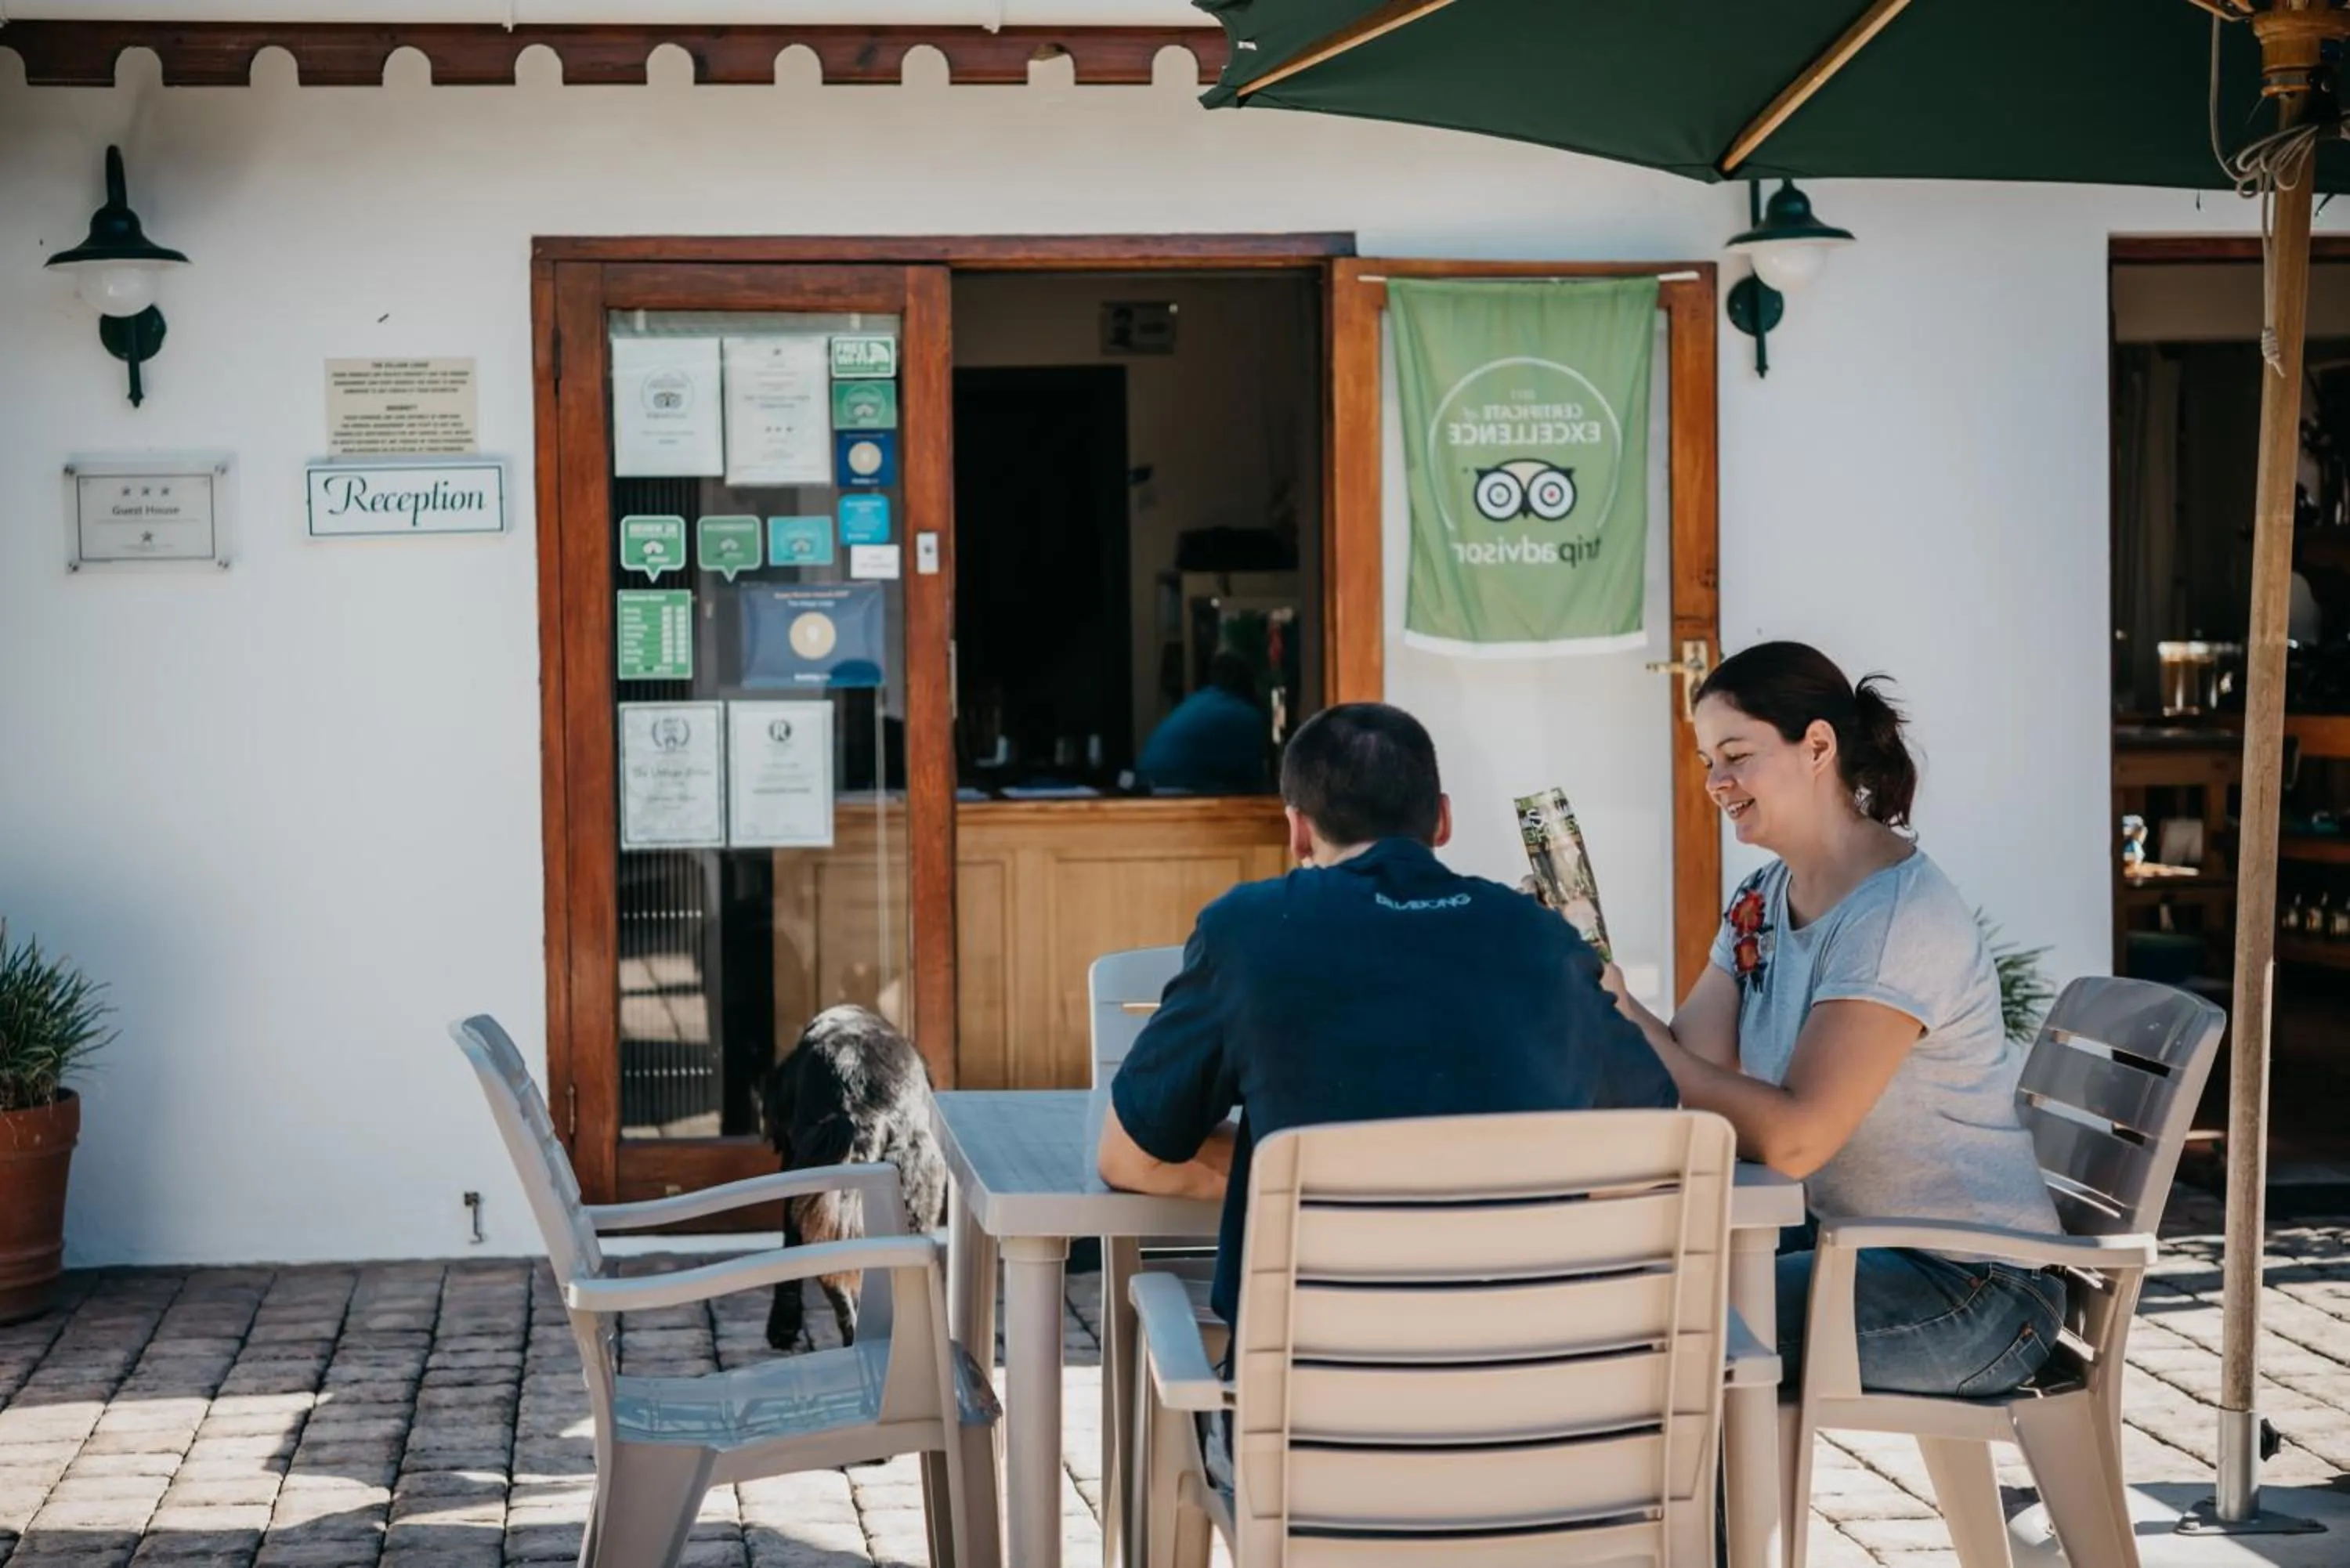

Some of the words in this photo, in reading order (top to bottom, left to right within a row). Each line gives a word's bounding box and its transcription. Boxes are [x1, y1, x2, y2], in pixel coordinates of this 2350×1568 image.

[112, 504, 143, 516] Guest
[145, 504, 180, 515] House
[323, 474, 485, 527] Reception
